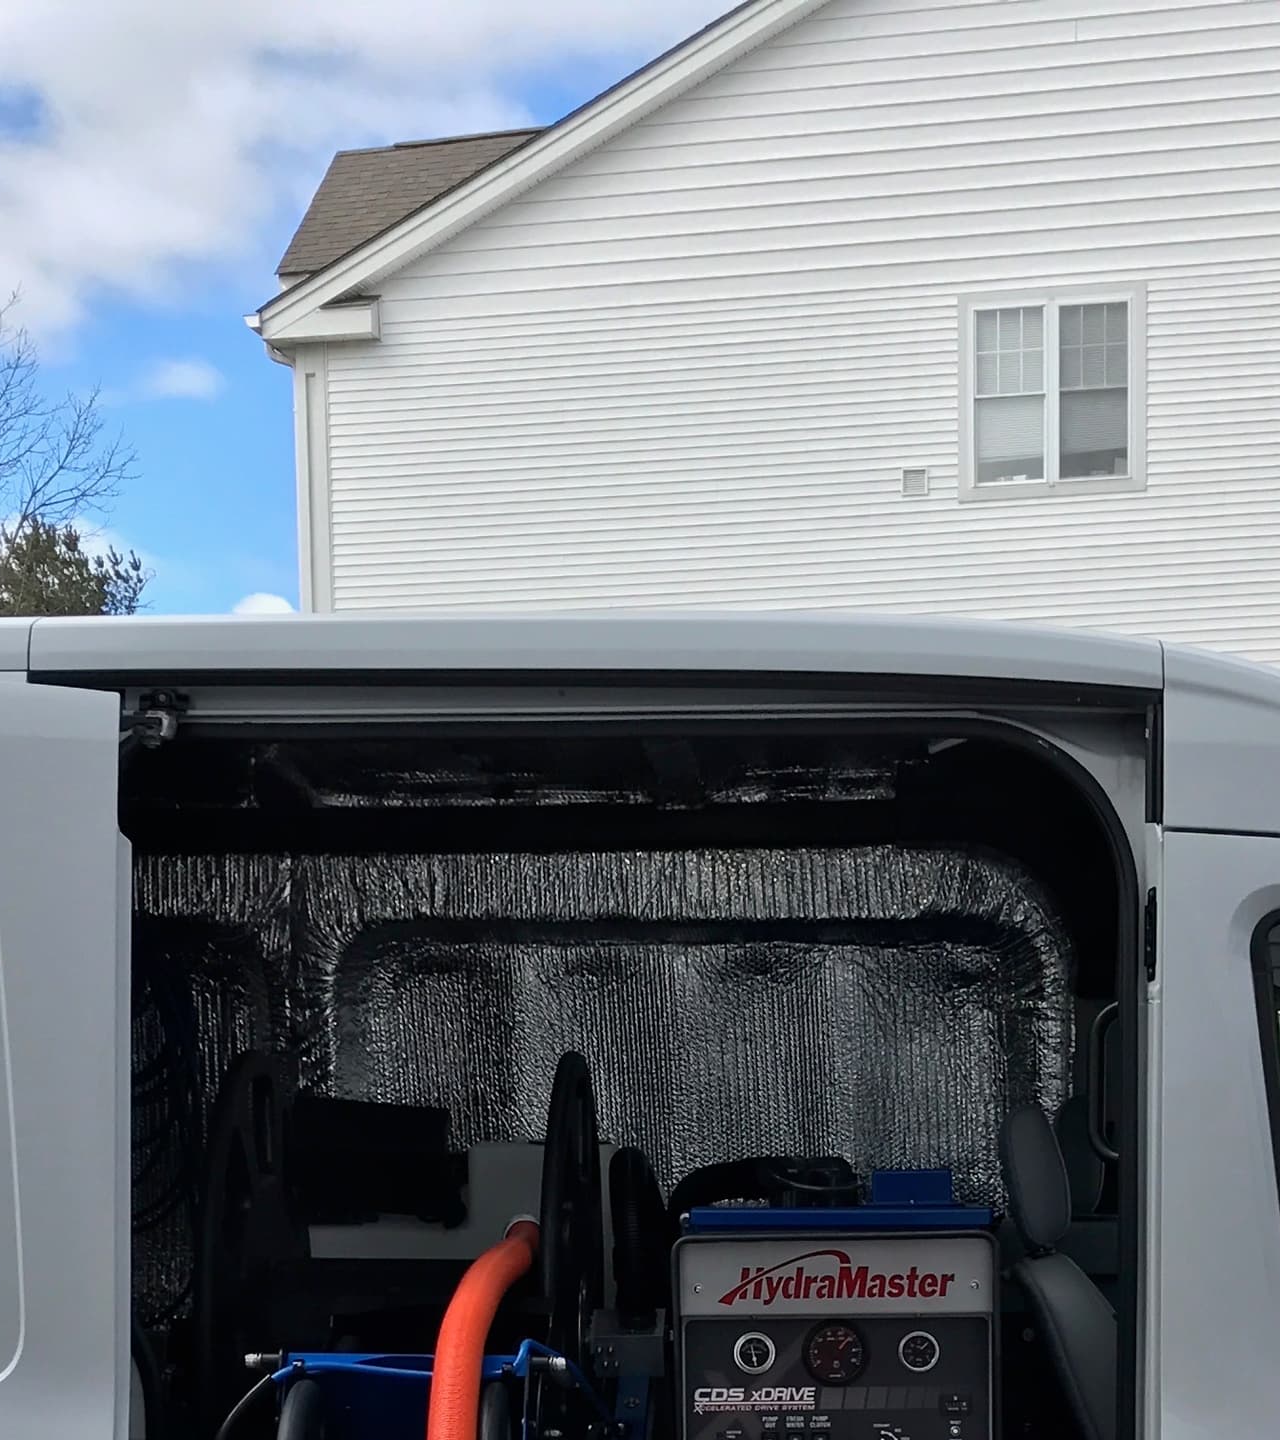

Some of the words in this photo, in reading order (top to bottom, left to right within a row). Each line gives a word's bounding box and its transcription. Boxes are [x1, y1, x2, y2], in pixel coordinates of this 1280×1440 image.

[734, 1261, 956, 1306] HydraMaster
[694, 1387, 745, 1402] CDS
[750, 1386, 817, 1401] xDRIVE
